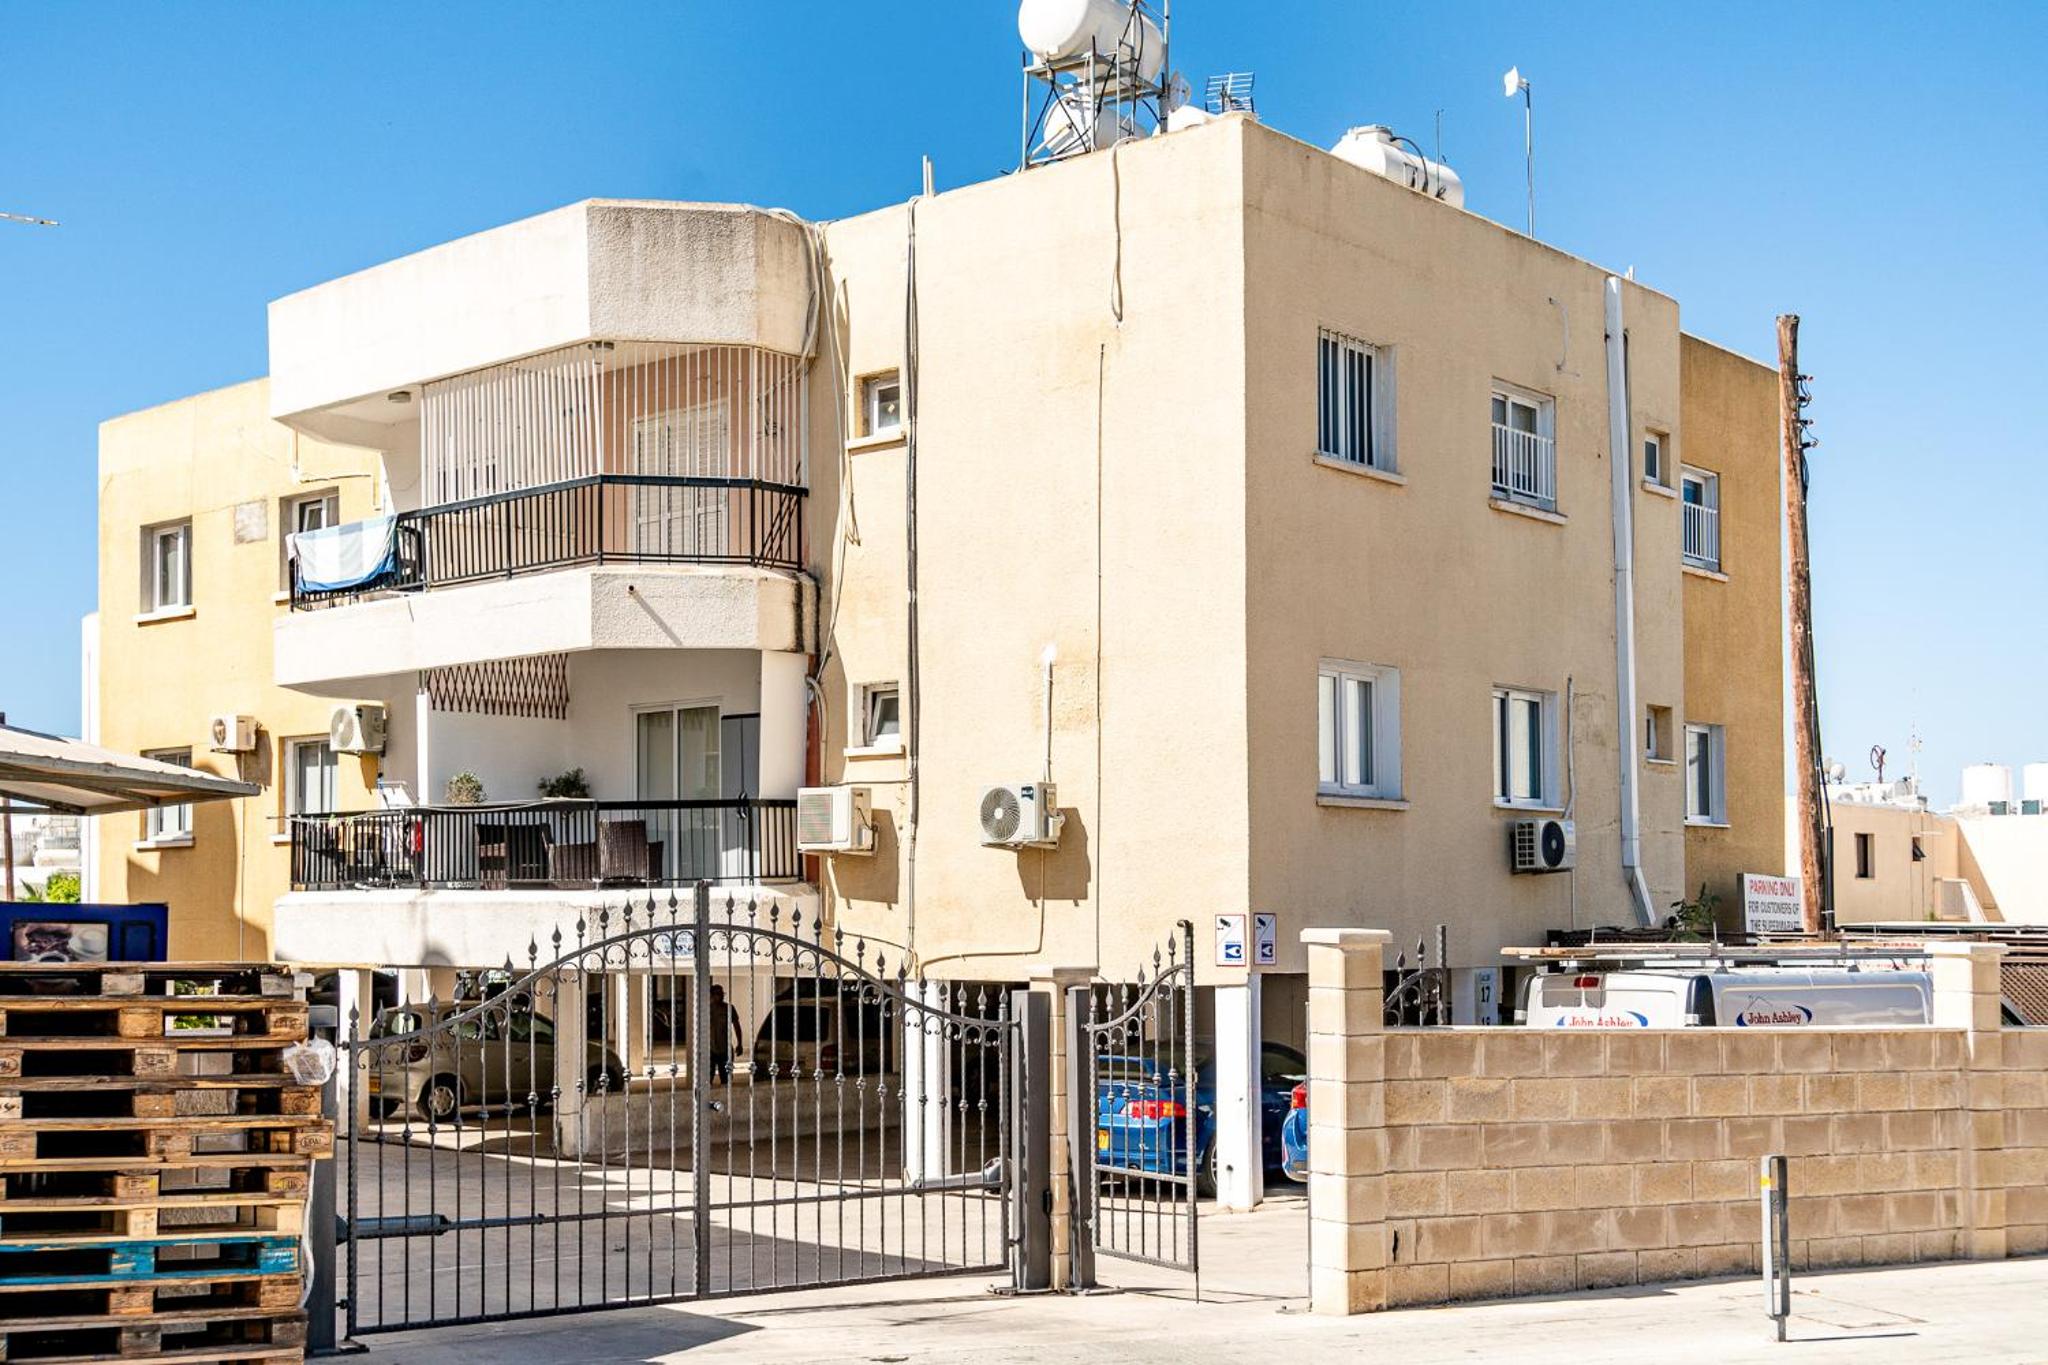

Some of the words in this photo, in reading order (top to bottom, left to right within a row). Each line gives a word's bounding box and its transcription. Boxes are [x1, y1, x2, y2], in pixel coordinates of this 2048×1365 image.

[1749, 879, 1778, 896] PARKING
[1748, 900, 1759, 913] FOR
[1760, 901, 1792, 914] CUSTOMERS
[1792, 902, 1800, 915] OF
[1481, 986, 1490, 1003] 17
[1569, 1016, 1594, 1027] John
[1748, 1012, 1771, 1024] John
[1772, 1011, 1801, 1024] Ashley
